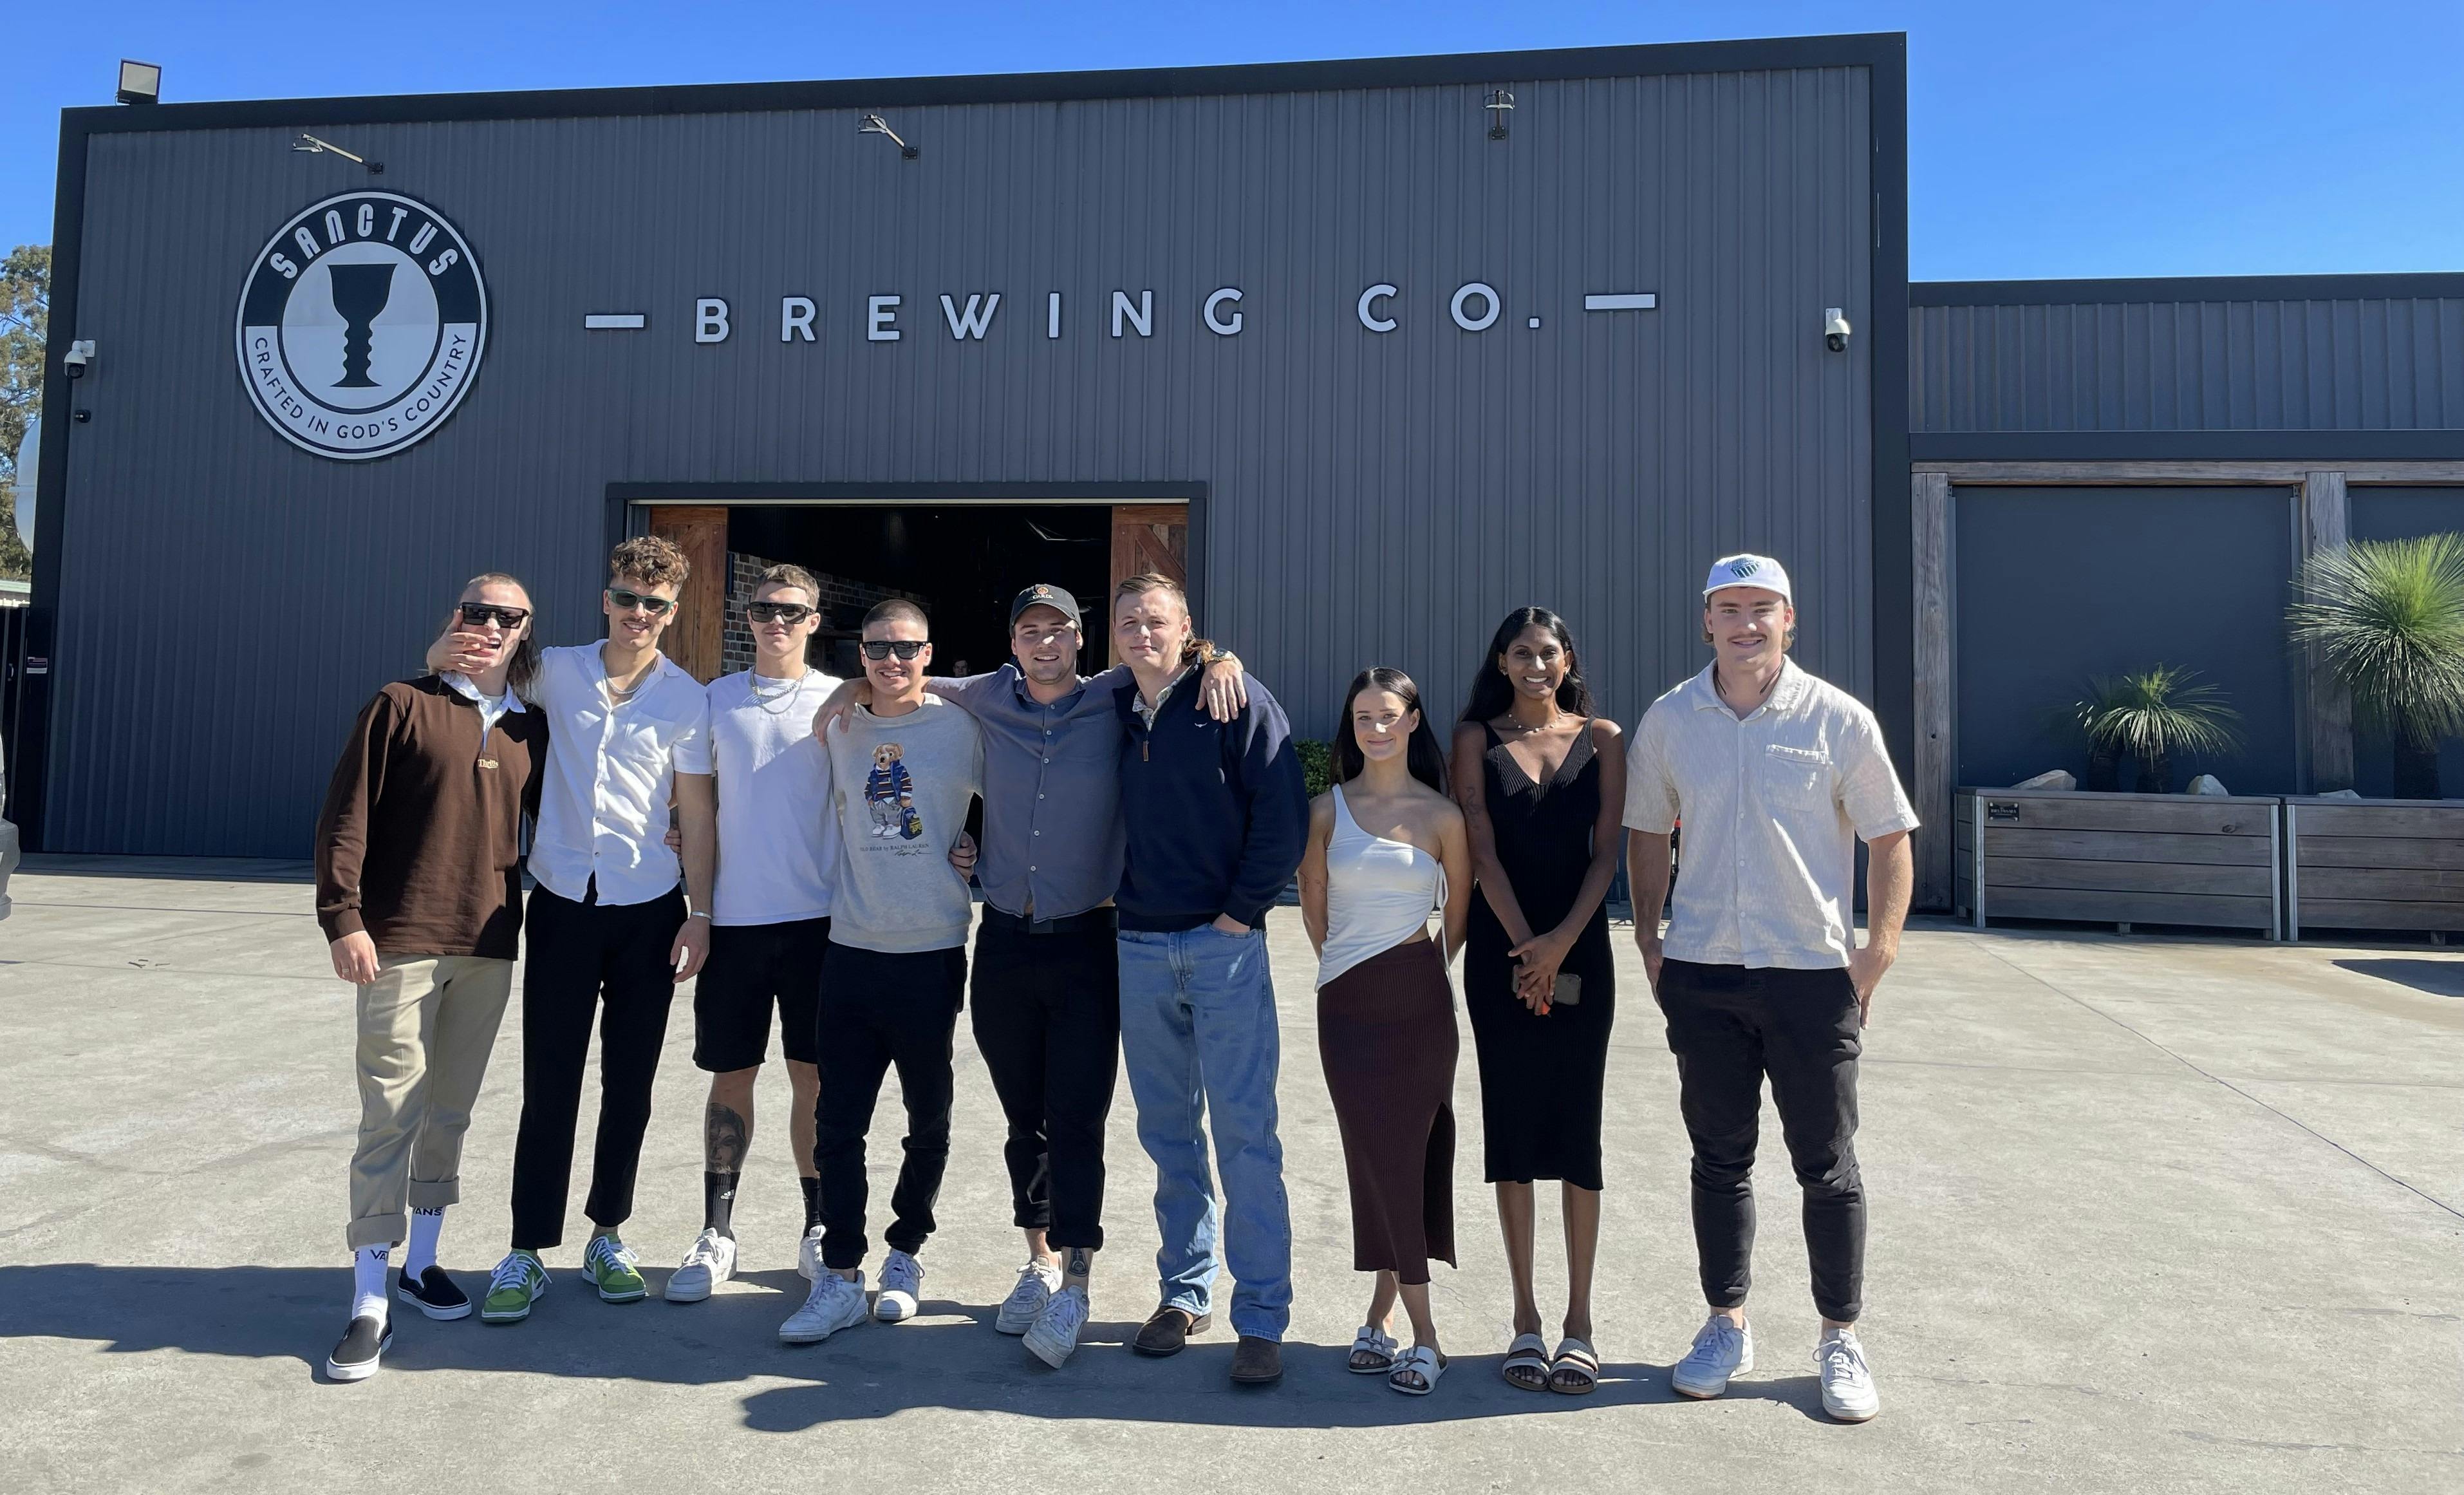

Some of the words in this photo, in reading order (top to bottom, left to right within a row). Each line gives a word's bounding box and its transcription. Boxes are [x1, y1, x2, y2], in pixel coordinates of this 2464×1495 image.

[270, 203, 458, 279] SANCTUS
[695, 288, 1243, 343] BREWING
[1358, 283, 1540, 332] CO.
[255, 337, 303, 419] CRAFTED
[307, 415, 329, 435] IN
[337, 417, 398, 439] GOD'S
[405, 334, 467, 421] COUNTRY
